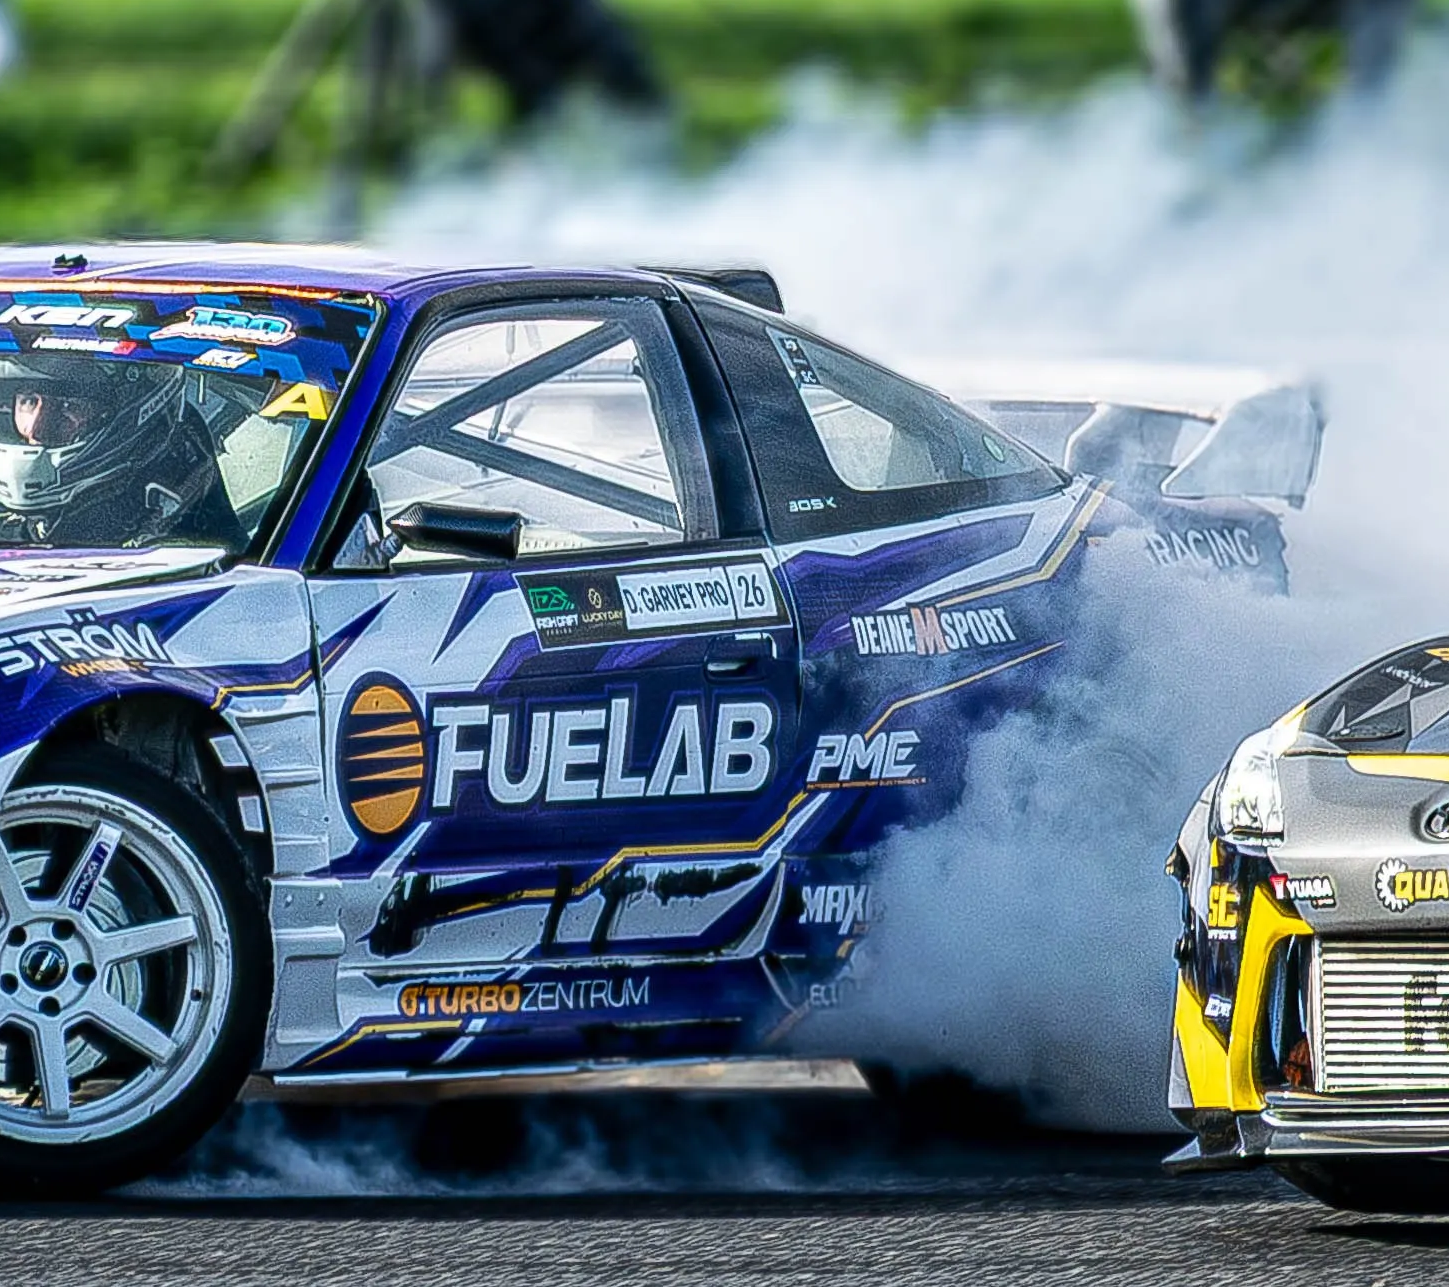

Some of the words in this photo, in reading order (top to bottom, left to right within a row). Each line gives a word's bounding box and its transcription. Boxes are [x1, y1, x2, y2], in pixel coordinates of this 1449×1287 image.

[258, 382, 328, 420] A
[1148, 527, 1260, 570] RACING
[642, 583, 694, 613] GARVEY
[696, 580, 729, 609] PRO
[737, 574, 766, 608] 26
[431, 698, 774, 808] FUELAB
[806, 730, 921, 782] PME
[1286, 876, 1334, 900] YUASA
